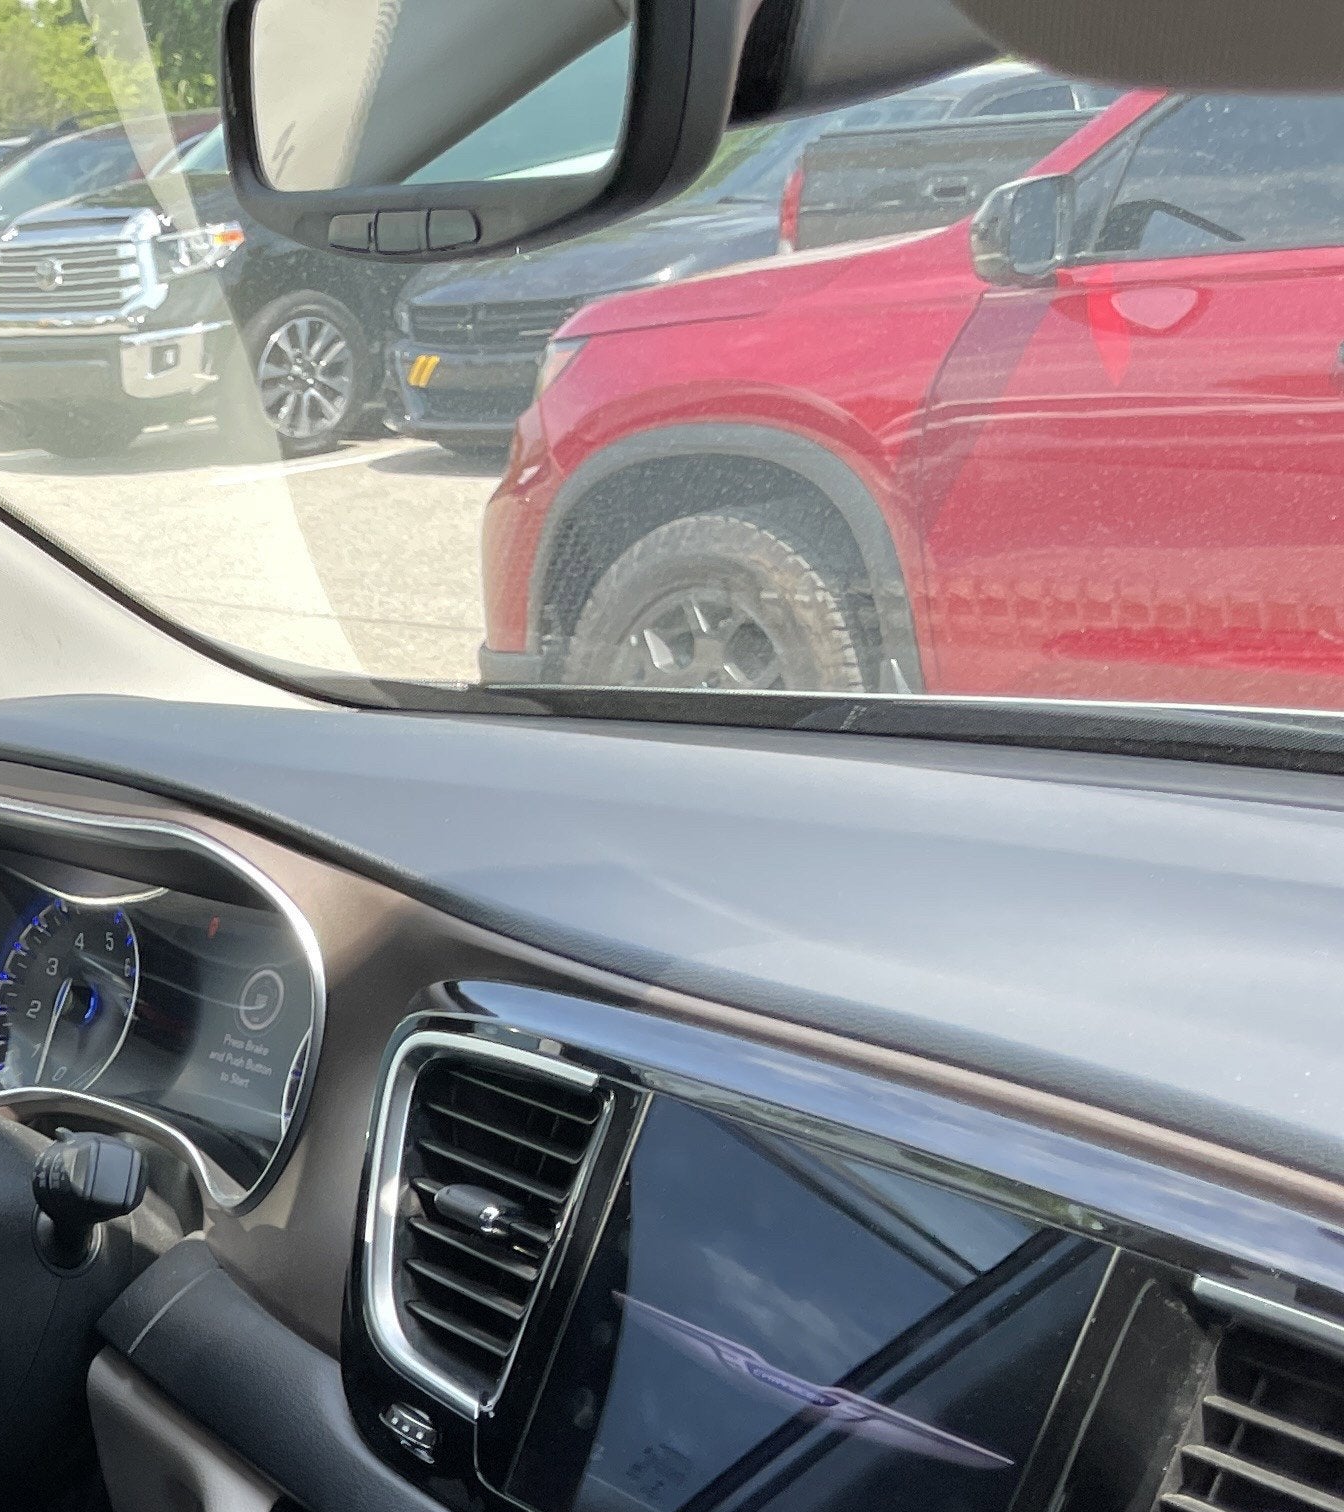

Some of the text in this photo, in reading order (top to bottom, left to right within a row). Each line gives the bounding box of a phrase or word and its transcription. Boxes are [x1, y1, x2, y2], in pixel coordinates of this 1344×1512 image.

[74, 932, 85, 951] 4
[105, 931, 115, 951] 5
[45, 957, 59, 976] 3
[25, 1000, 42, 1019] 2
